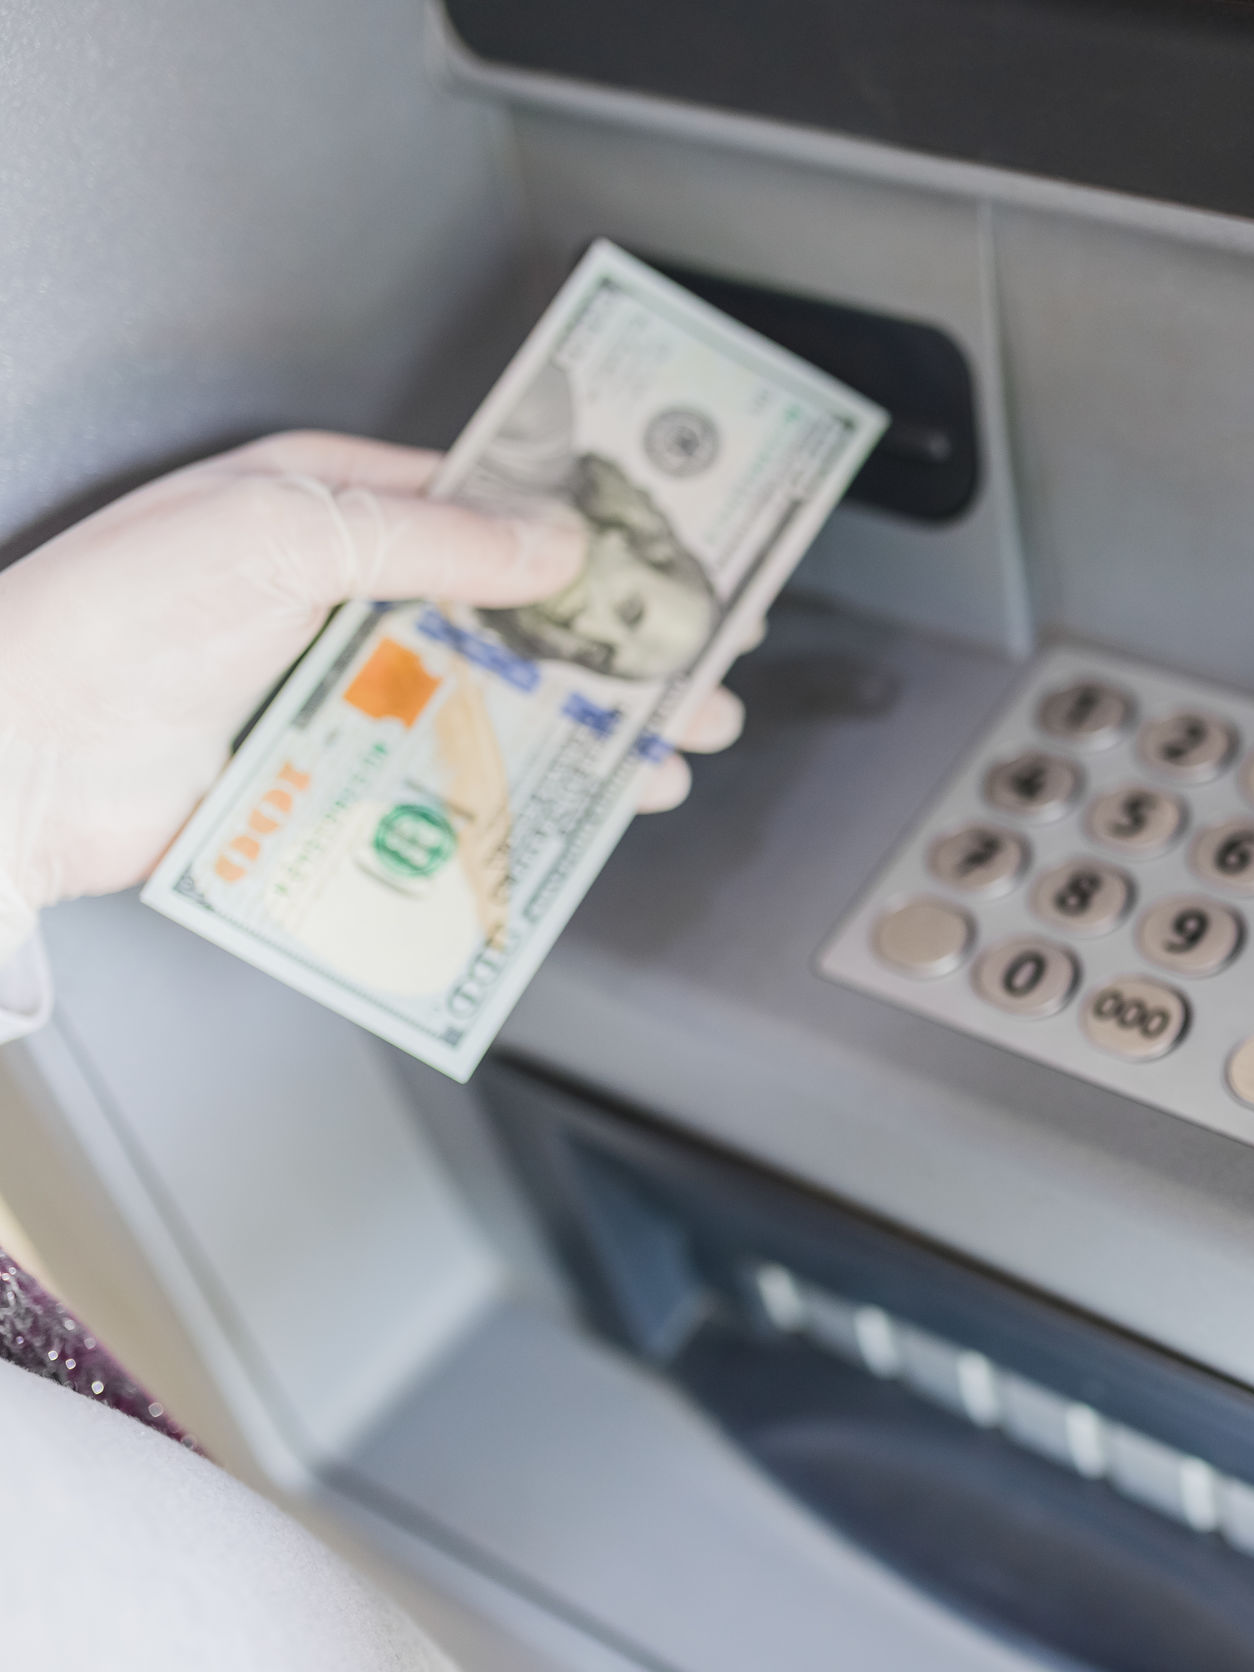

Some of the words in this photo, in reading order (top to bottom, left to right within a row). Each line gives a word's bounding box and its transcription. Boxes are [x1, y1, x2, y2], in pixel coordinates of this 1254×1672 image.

[1160, 715, 1208, 766] 2
[214, 761, 312, 884] 100
[1110, 790, 1156, 838] 5
[1054, 870, 1103, 917] 8
[1164, 907, 1210, 954] 9
[1002, 950, 1048, 997] 0
[1092, 990, 1172, 1040] 000
